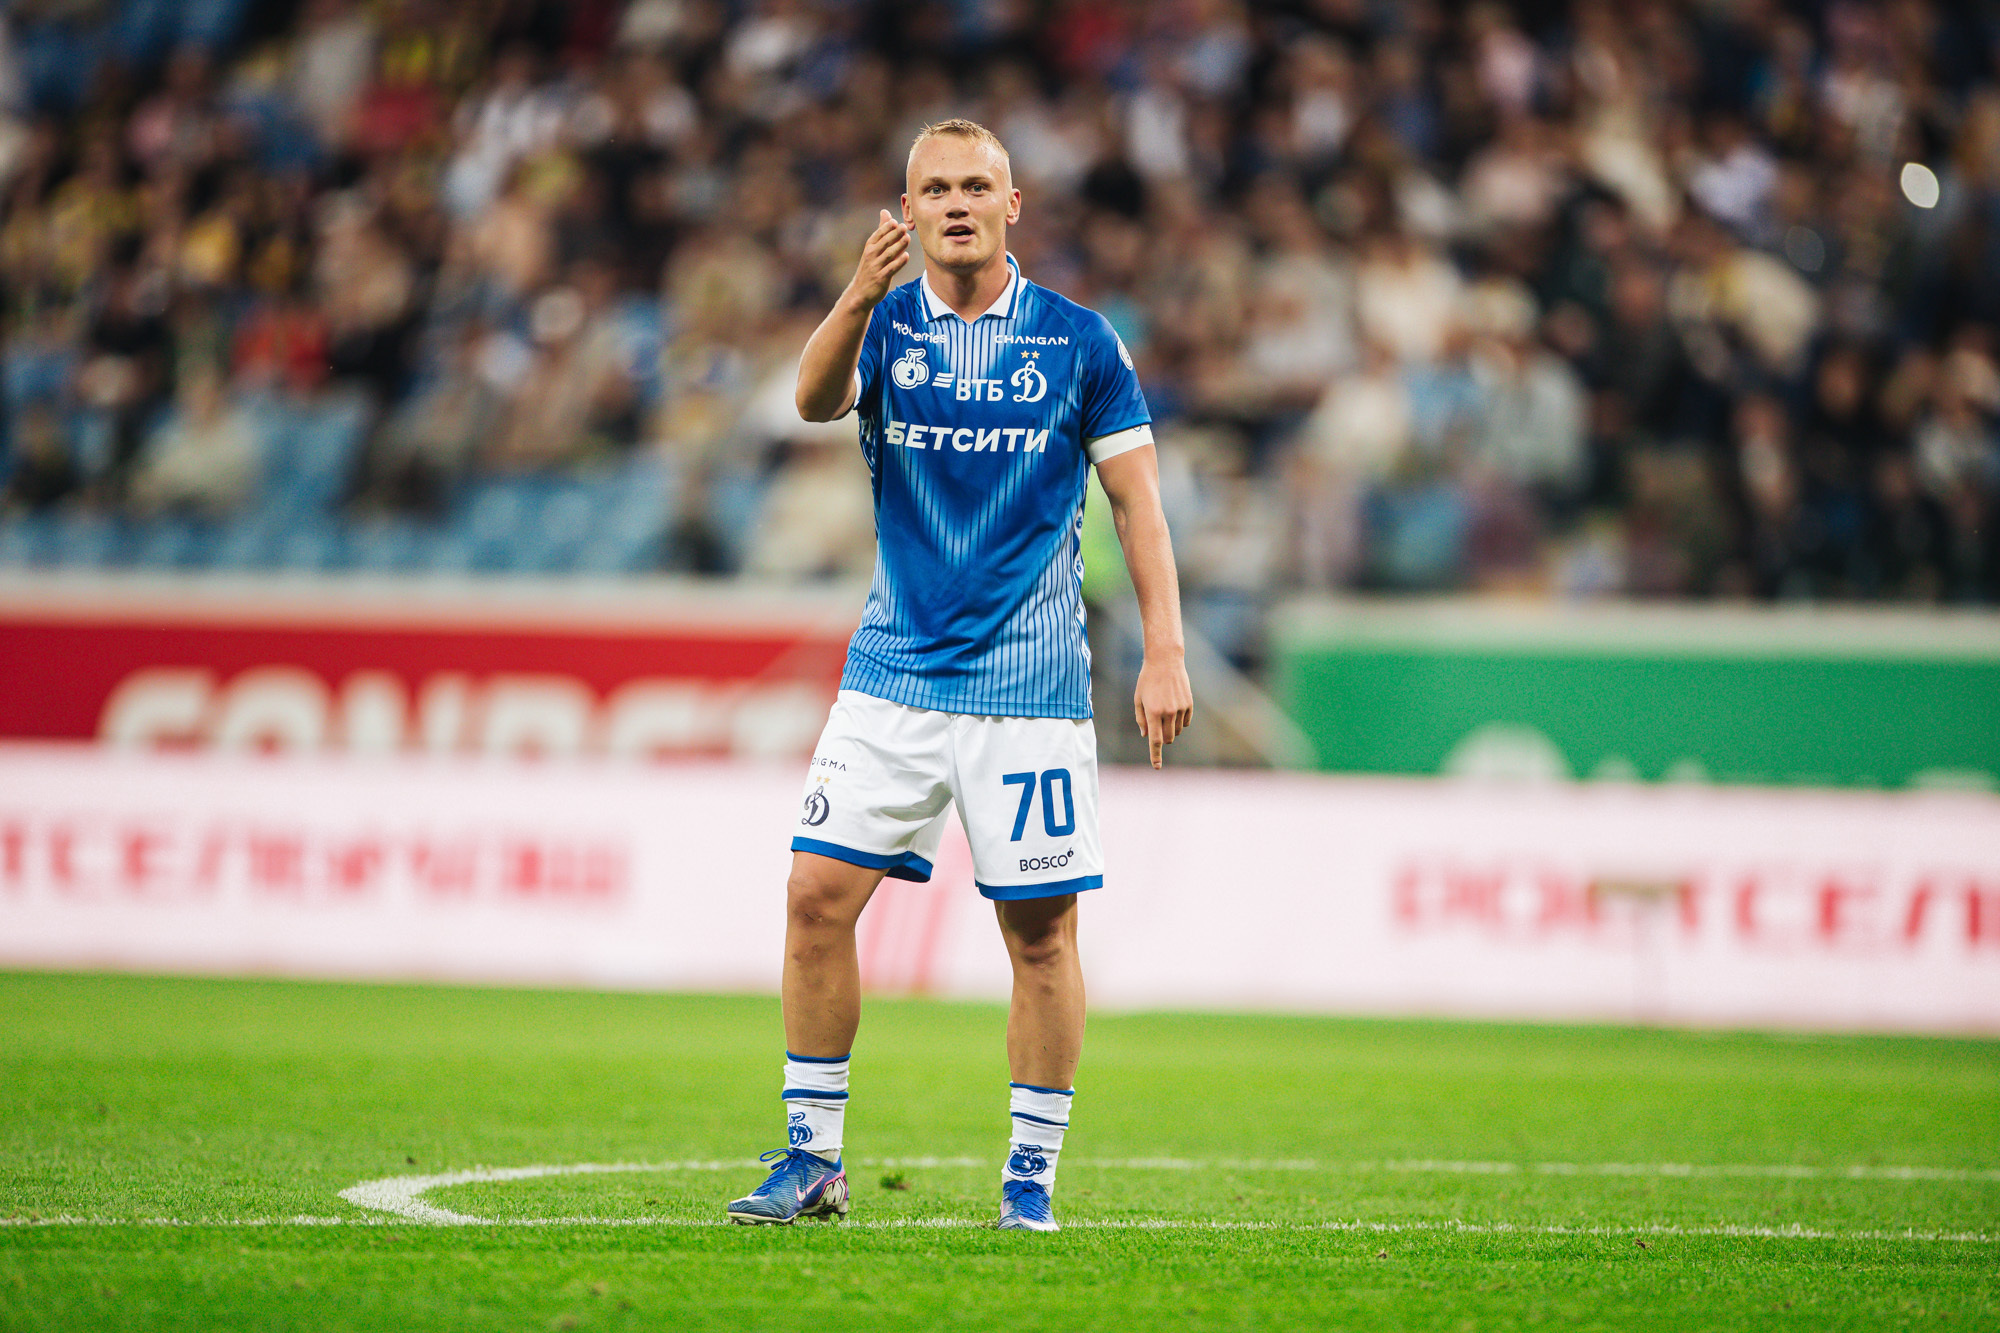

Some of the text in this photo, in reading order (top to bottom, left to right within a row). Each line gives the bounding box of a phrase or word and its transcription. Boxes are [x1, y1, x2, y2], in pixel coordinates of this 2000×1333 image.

[994, 334, 1069, 346] CHANGAN
[956, 379, 1003, 401] ВТБ
[884, 420, 1050, 454] БЕТСИТИ
[1002, 767, 1076, 842] 70
[1019, 854, 1069, 872] BOSCO
